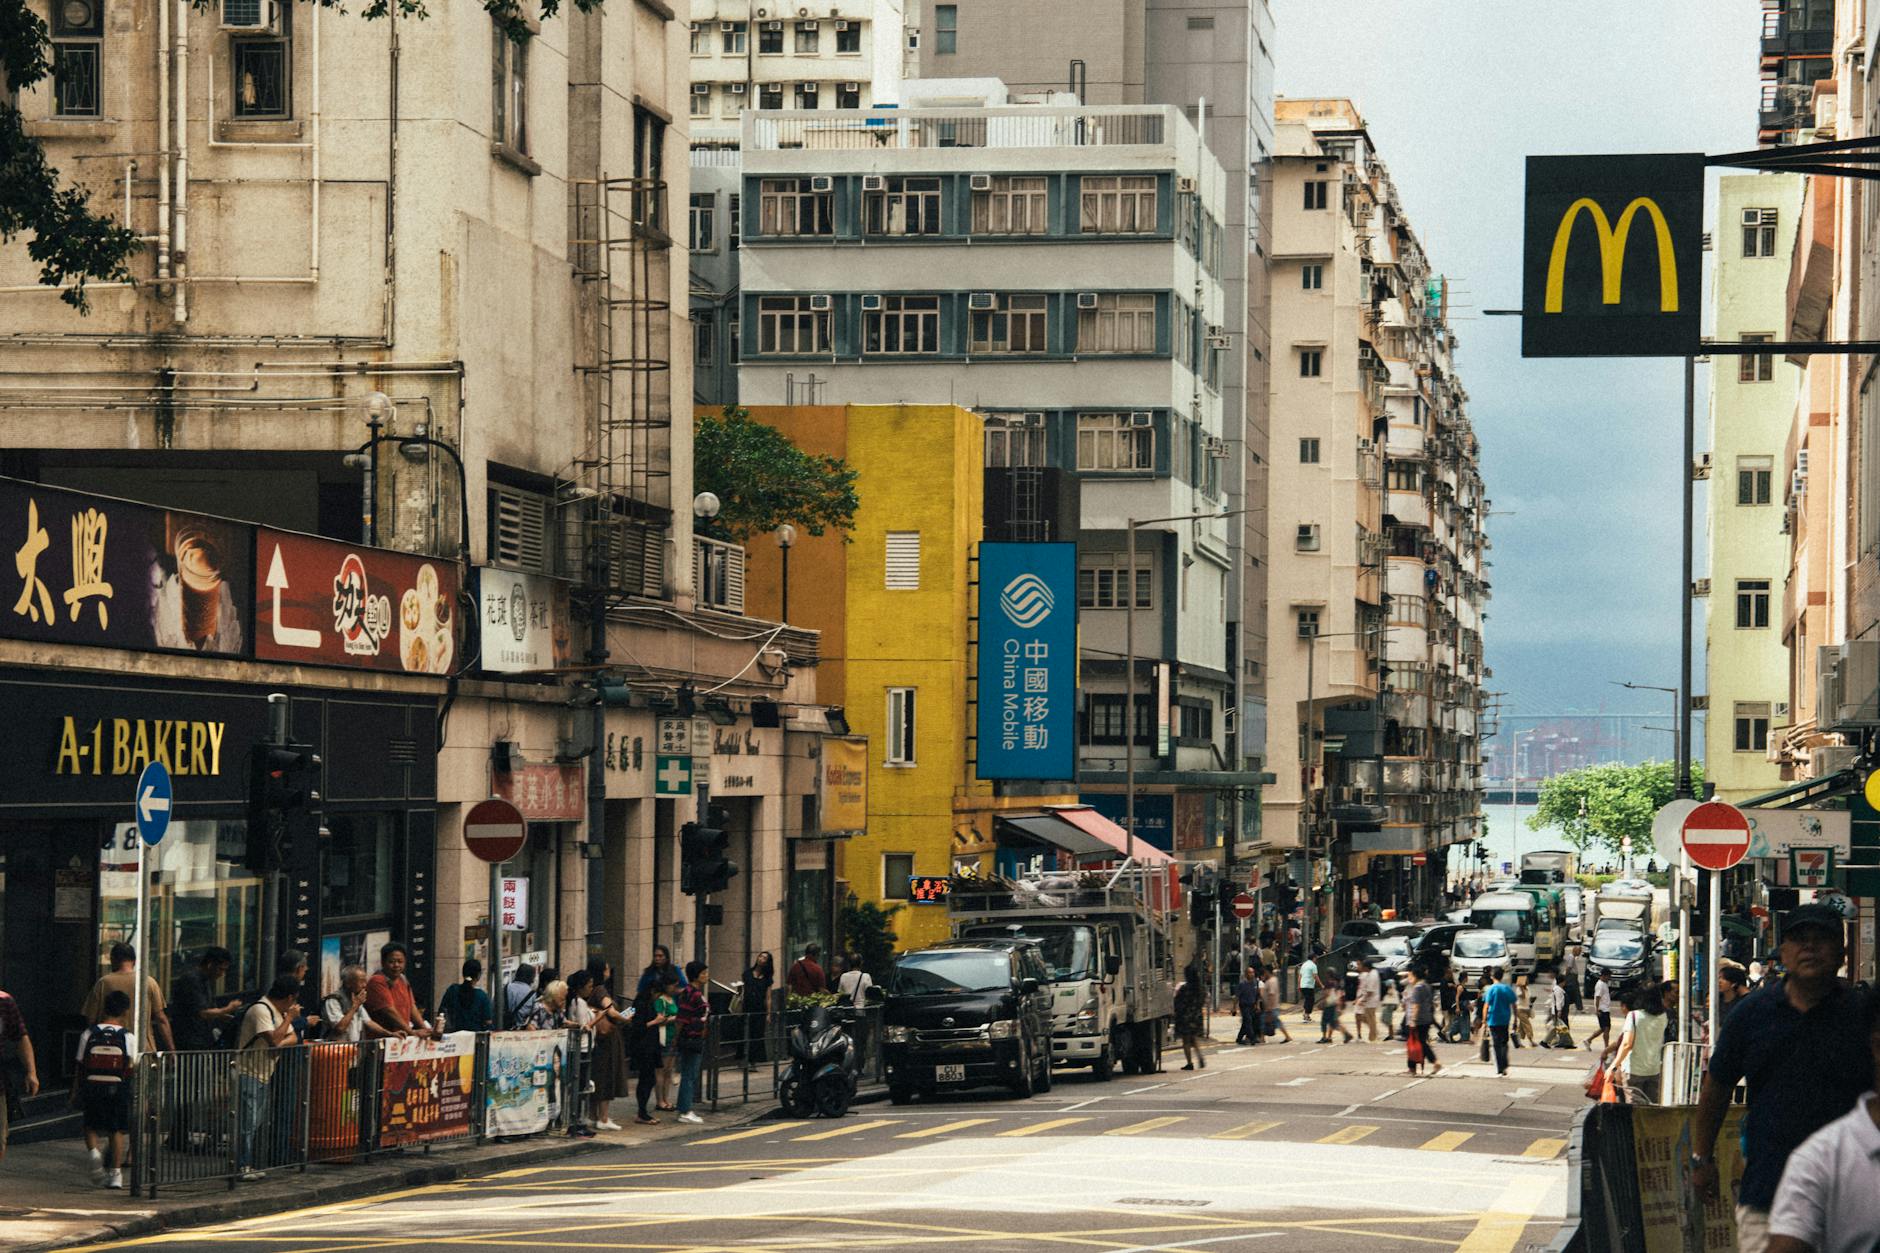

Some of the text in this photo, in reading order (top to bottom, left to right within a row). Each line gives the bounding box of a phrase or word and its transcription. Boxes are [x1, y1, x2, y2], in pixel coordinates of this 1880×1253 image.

[56, 716, 225, 775] A-1 BAKERY
[1003, 638, 1020, 750] China Mobile
[1023, 639, 1050, 750] 中國移動
